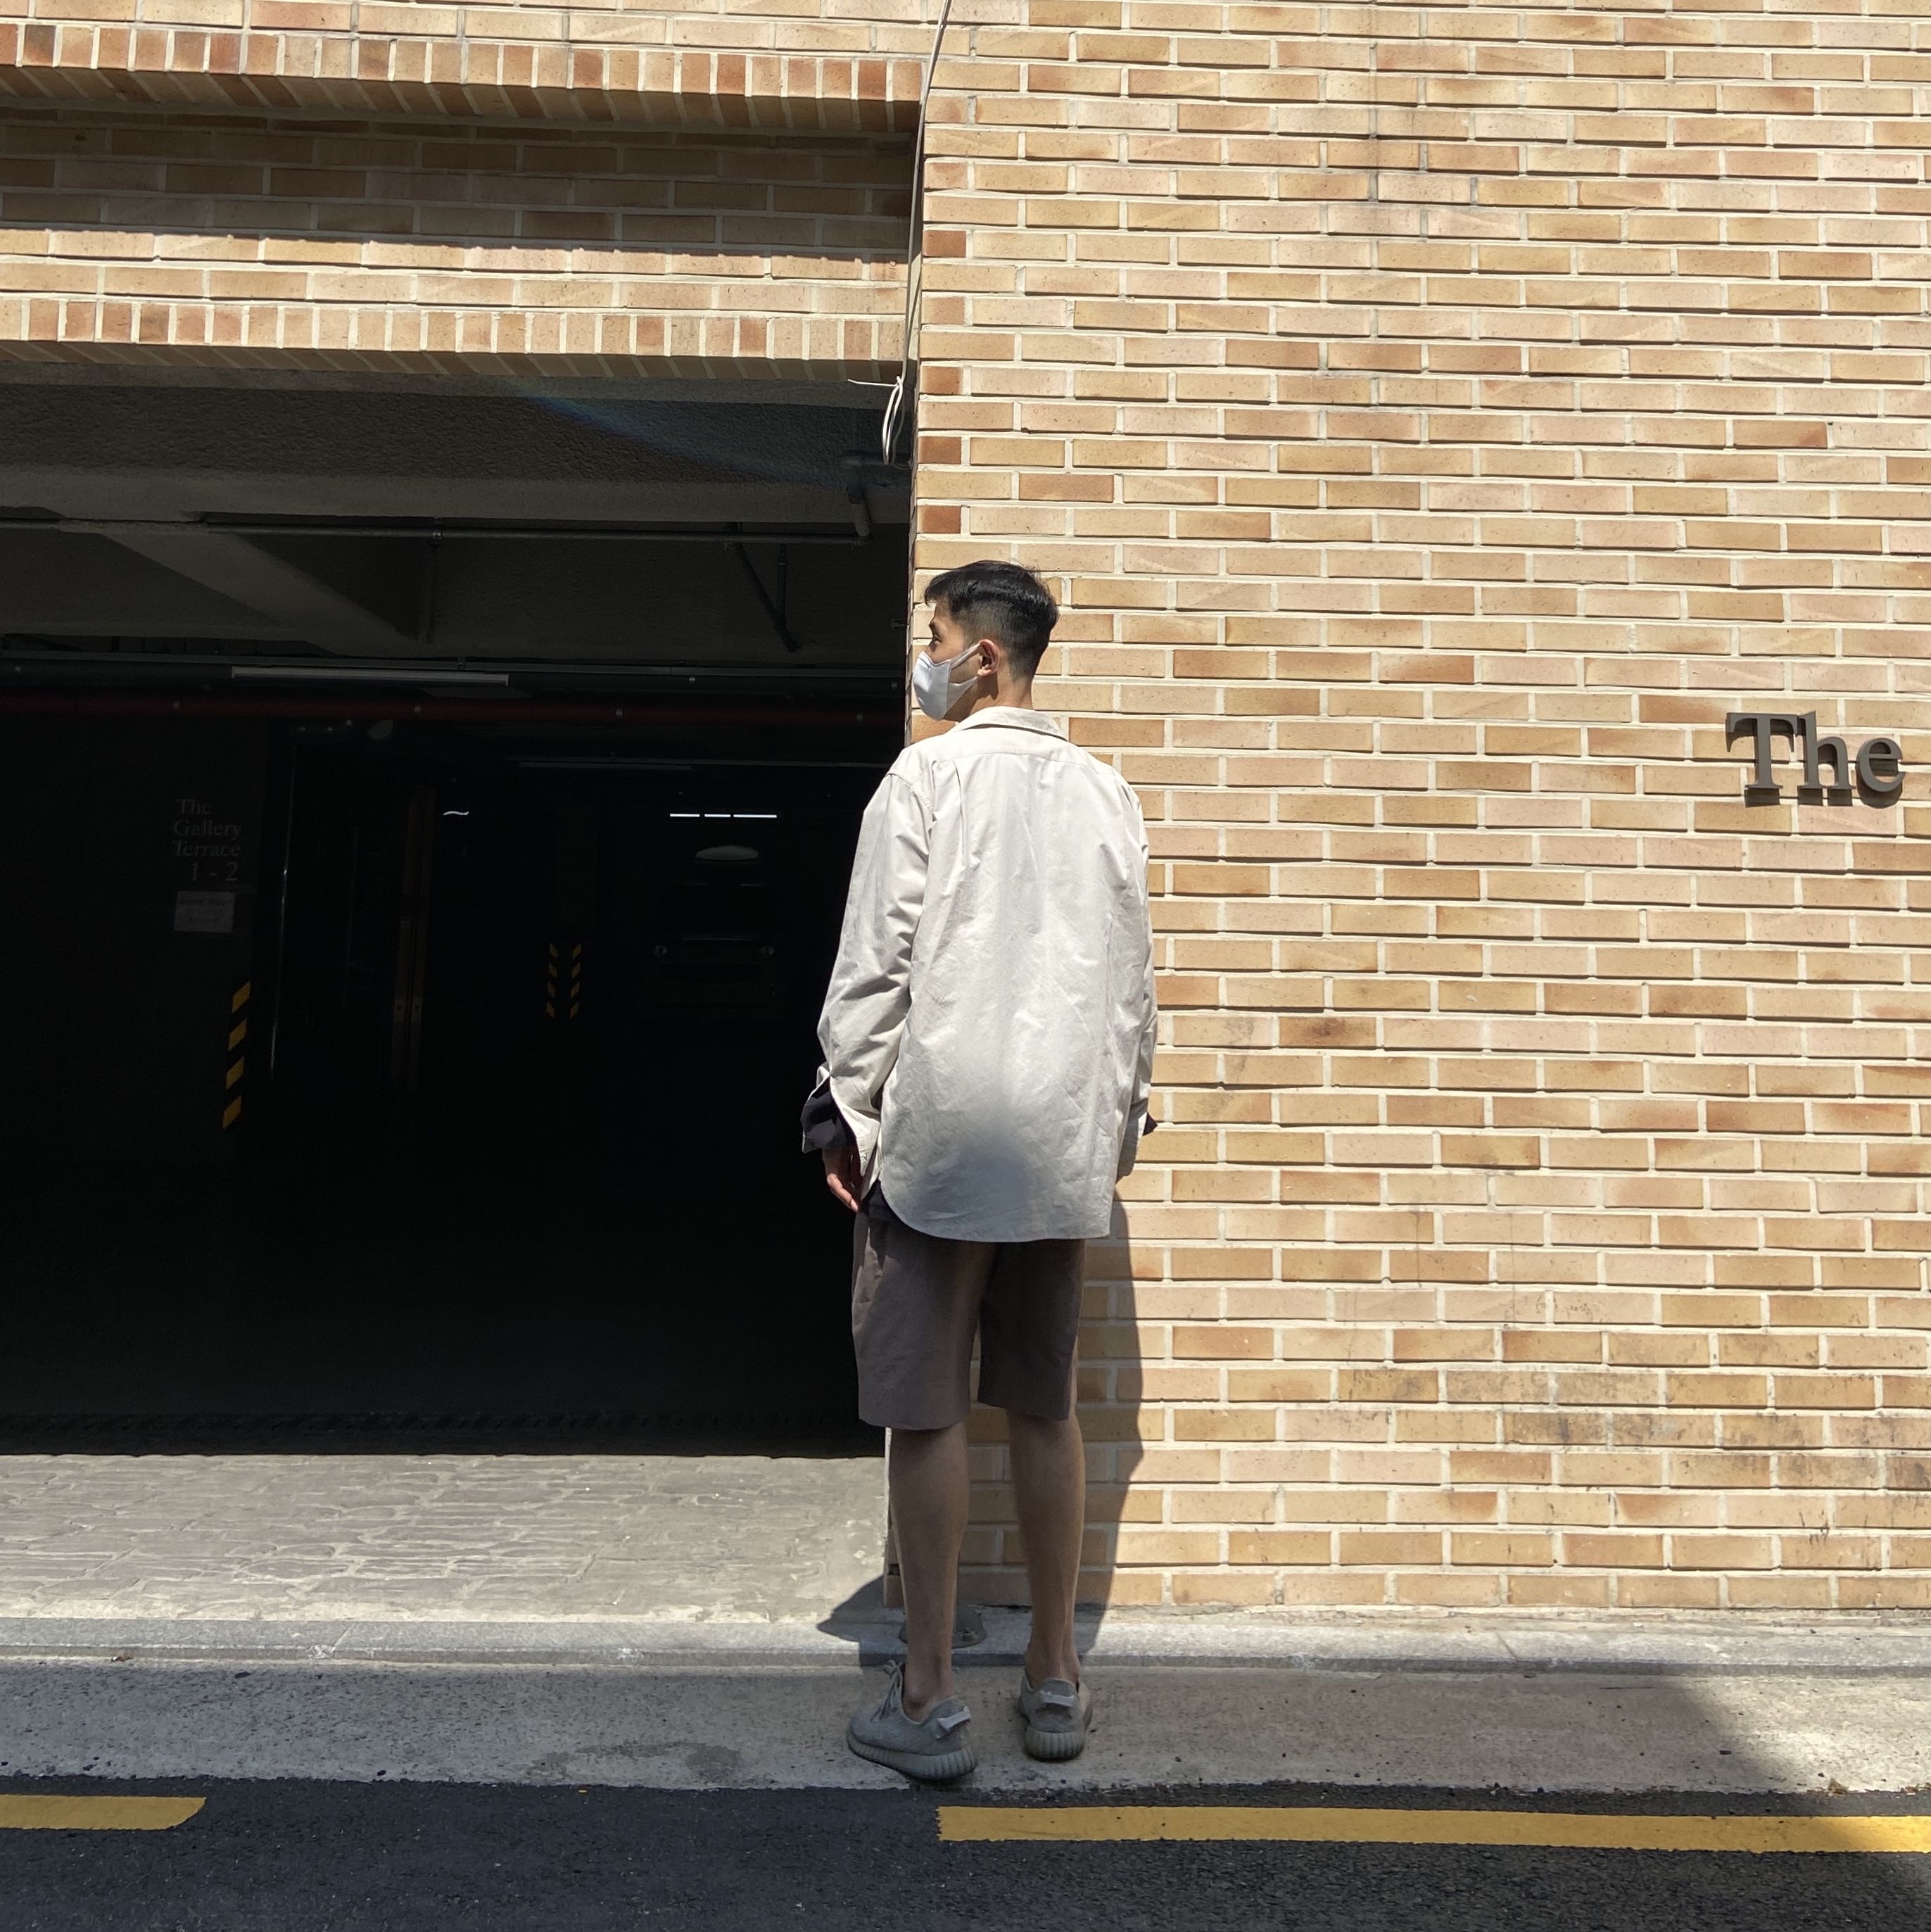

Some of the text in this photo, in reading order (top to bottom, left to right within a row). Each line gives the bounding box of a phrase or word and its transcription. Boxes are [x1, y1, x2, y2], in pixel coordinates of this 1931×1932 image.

[1726, 710, 1906, 800] The
[176, 798, 213, 815] The
[173, 819, 242, 840] Gallery
[172, 840, 241, 857] Terrace
